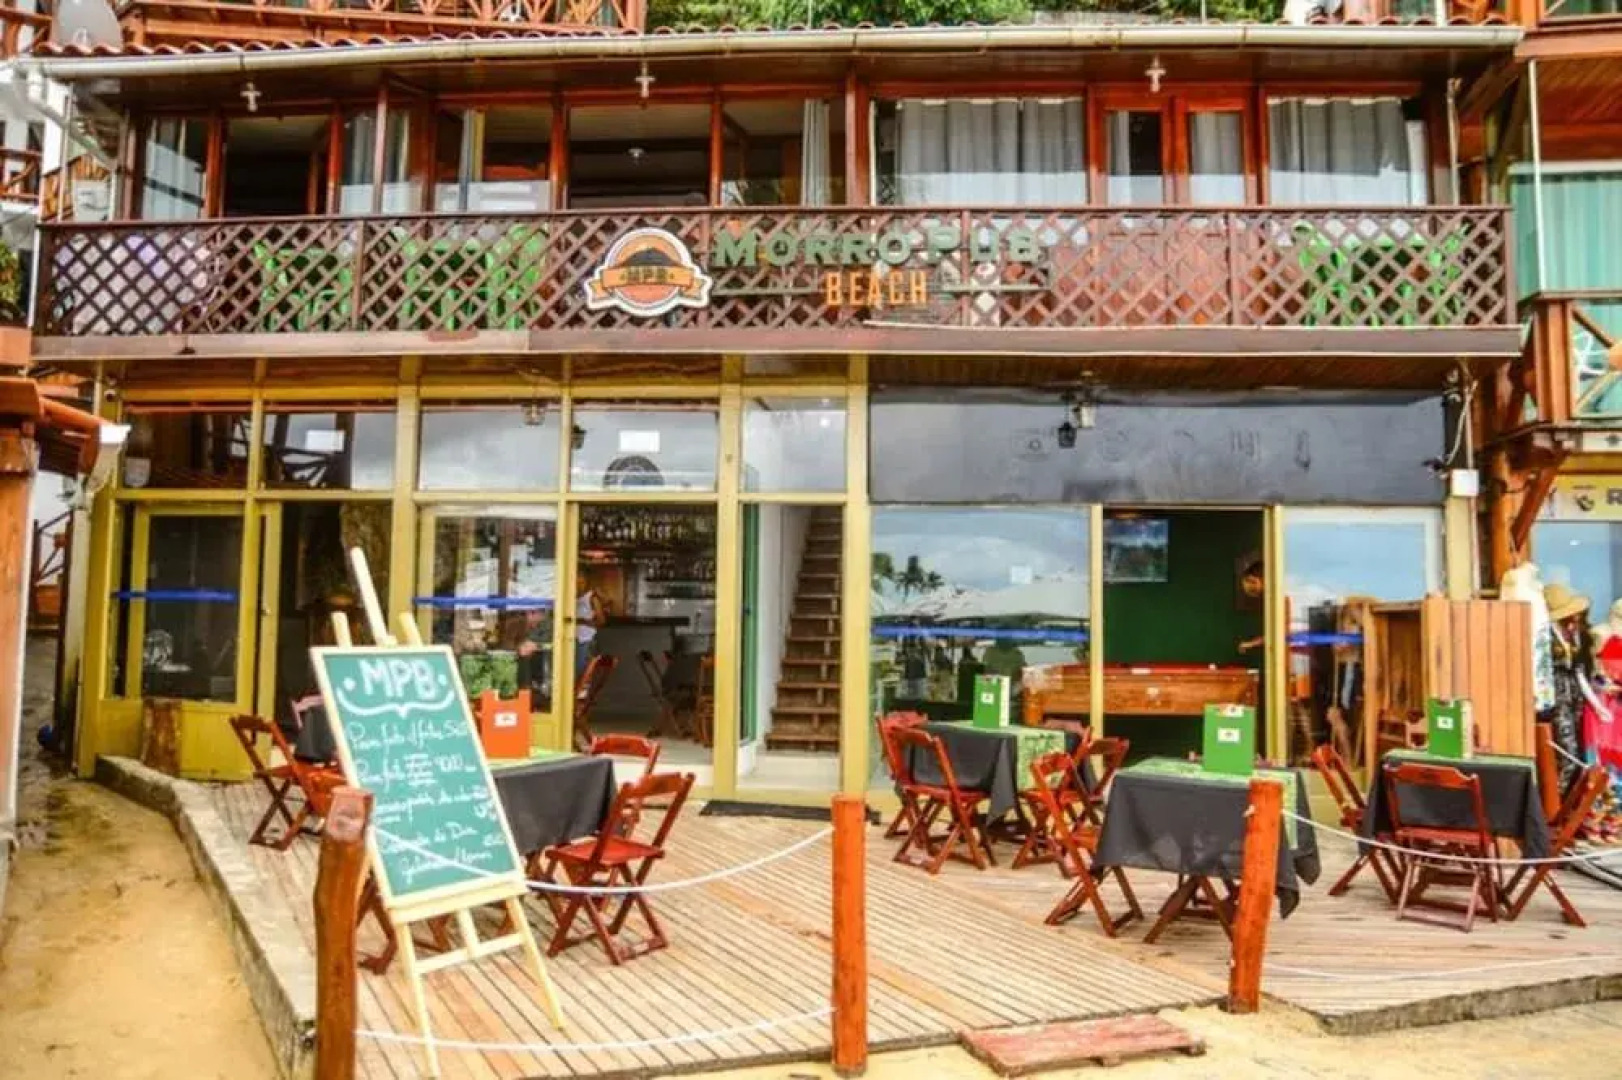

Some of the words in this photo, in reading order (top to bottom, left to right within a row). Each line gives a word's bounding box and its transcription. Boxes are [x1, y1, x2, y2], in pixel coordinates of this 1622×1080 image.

[711, 229, 911, 268] MORRO
[926, 224, 1041, 264] PUB
[626, 265, 668, 285] MPB
[824, 267, 928, 309] BEACH
[358, 657, 438, 700] MPB
